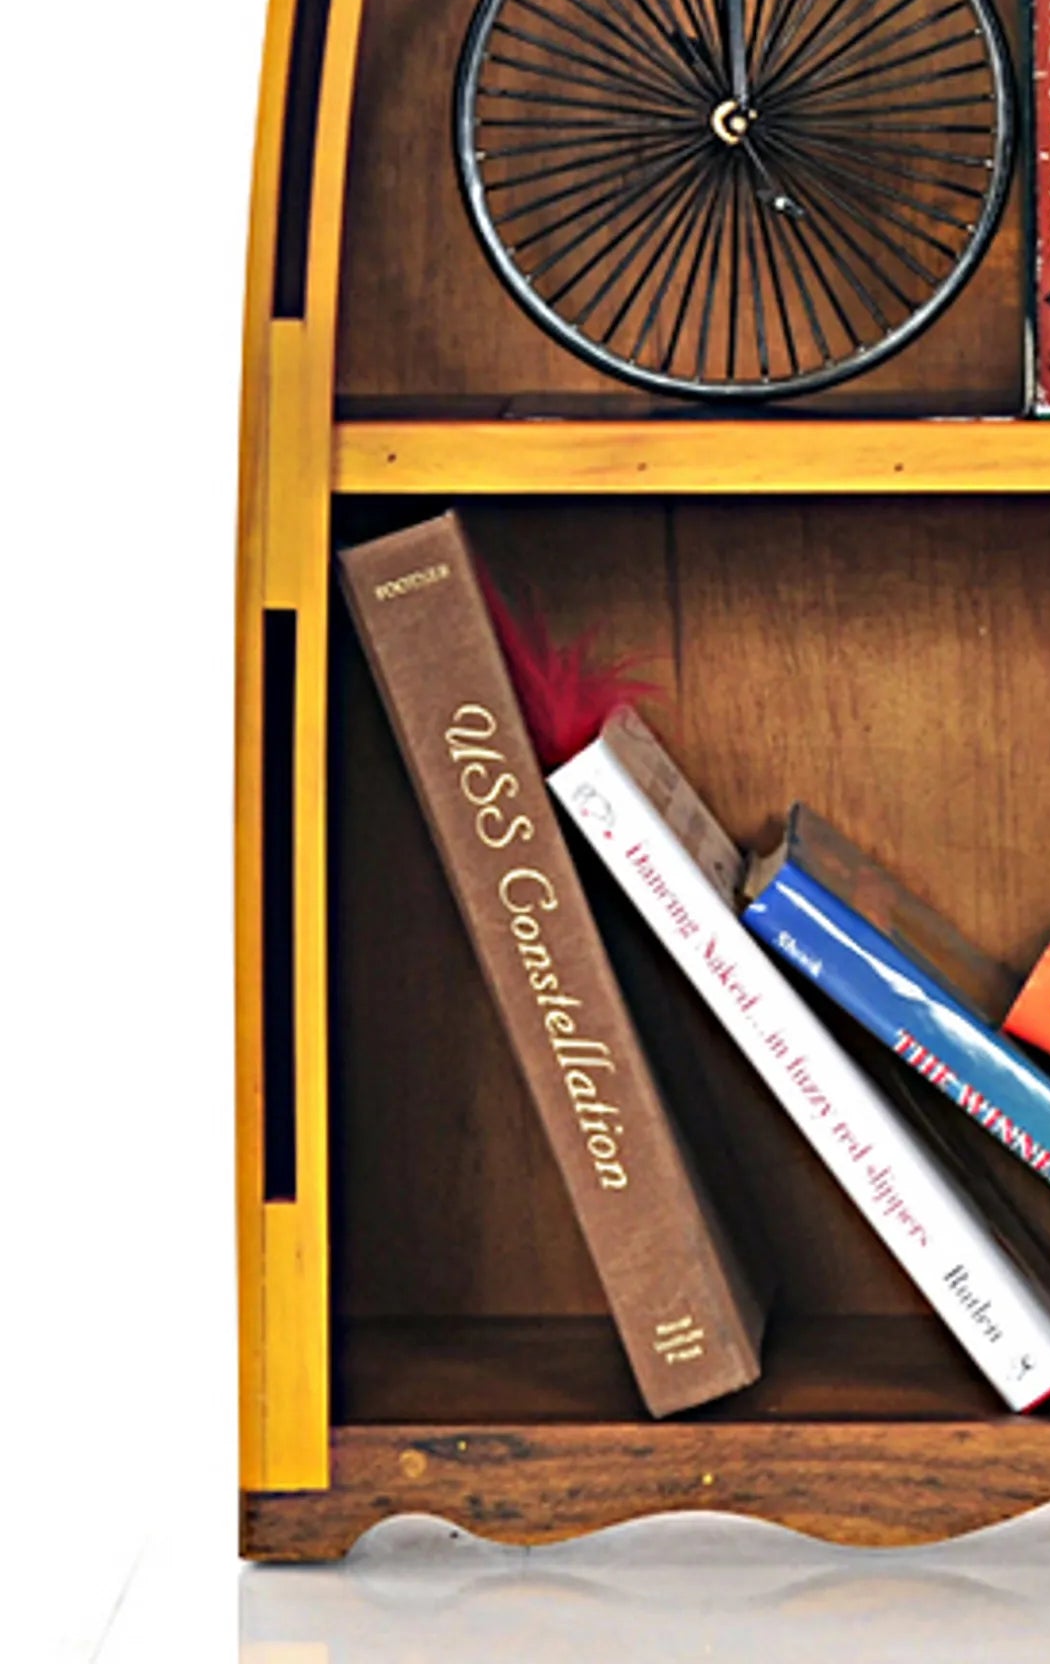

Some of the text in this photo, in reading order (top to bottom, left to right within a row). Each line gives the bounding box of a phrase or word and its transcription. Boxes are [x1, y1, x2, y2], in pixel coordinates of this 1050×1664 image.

[444, 702, 629, 1191] USS Constellation
[624, 842, 701, 940] Dancing
[782, 1051, 833, 1119] fuzzy
[831, 1121, 869, 1164] red
[865, 1163, 931, 1248] slippers
[895, 1027, 952, 1092] THE
